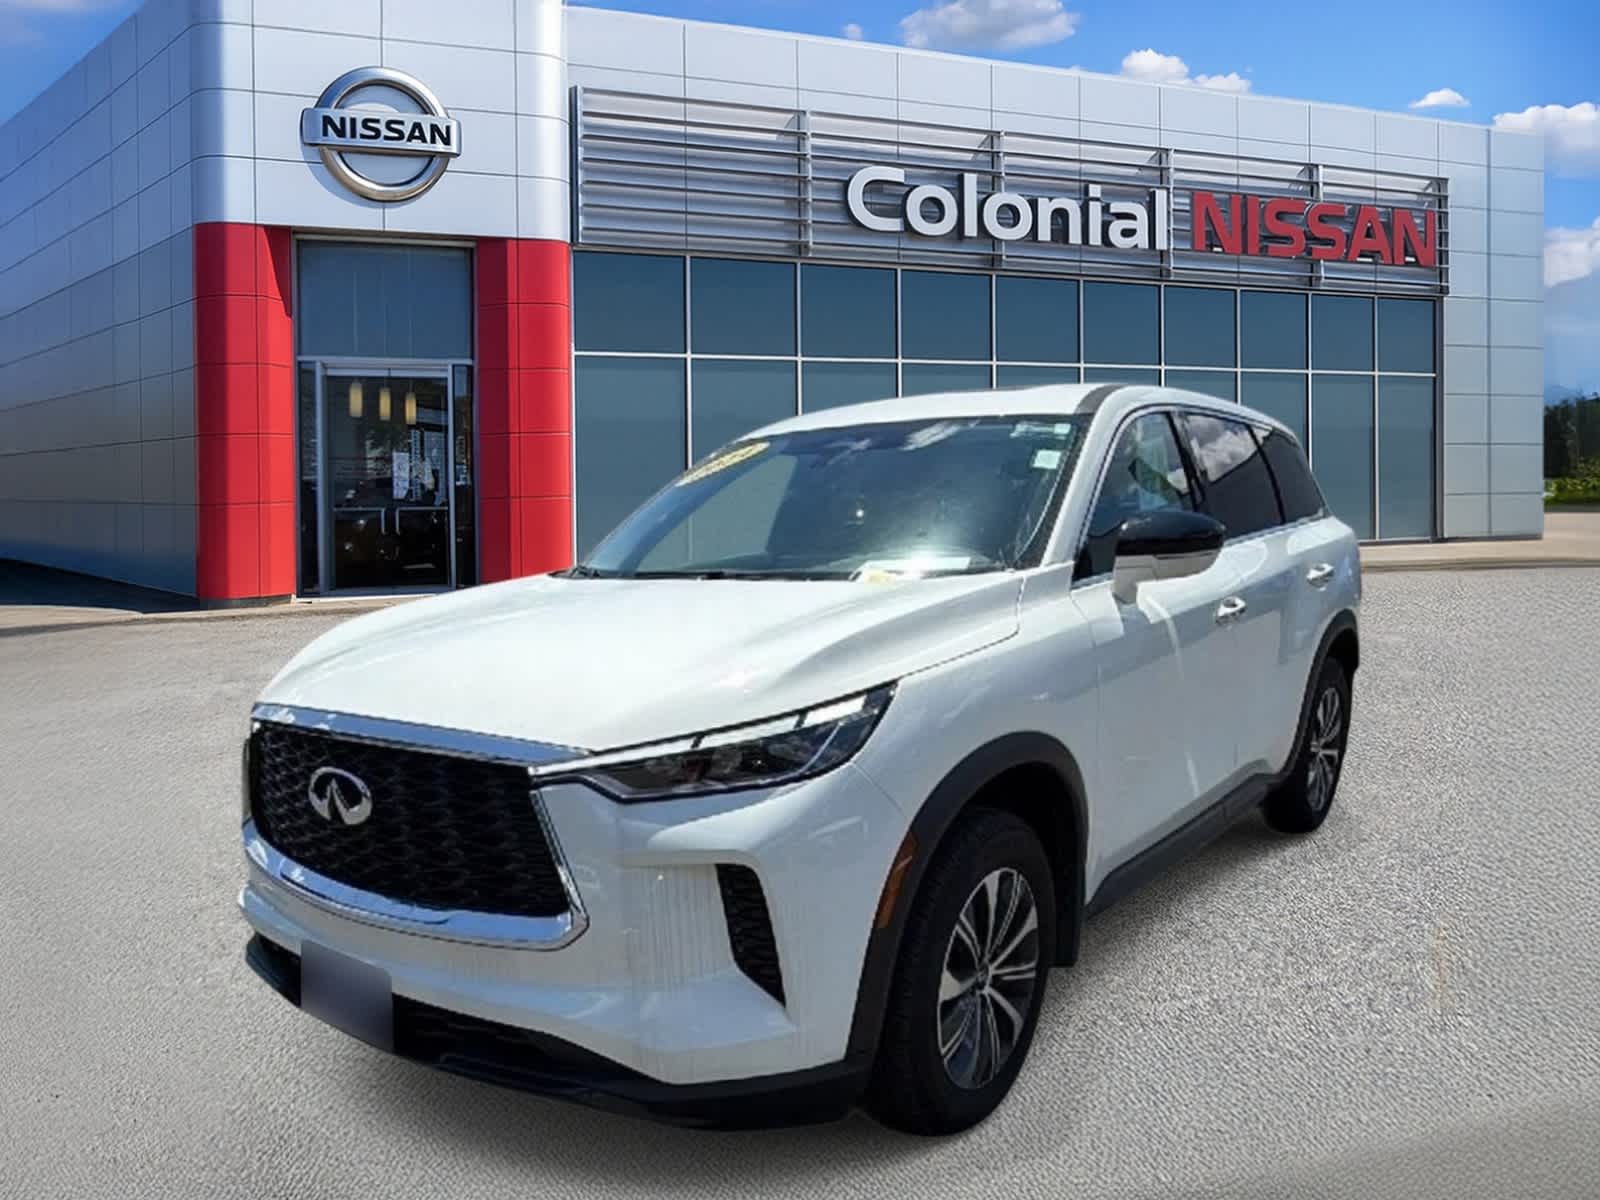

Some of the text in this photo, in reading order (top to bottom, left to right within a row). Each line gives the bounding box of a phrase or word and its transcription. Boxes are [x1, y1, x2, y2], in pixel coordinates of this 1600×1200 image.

[321, 115, 451, 146] NISSAN
[847, 165, 1437, 268] Colonial NISSAN
